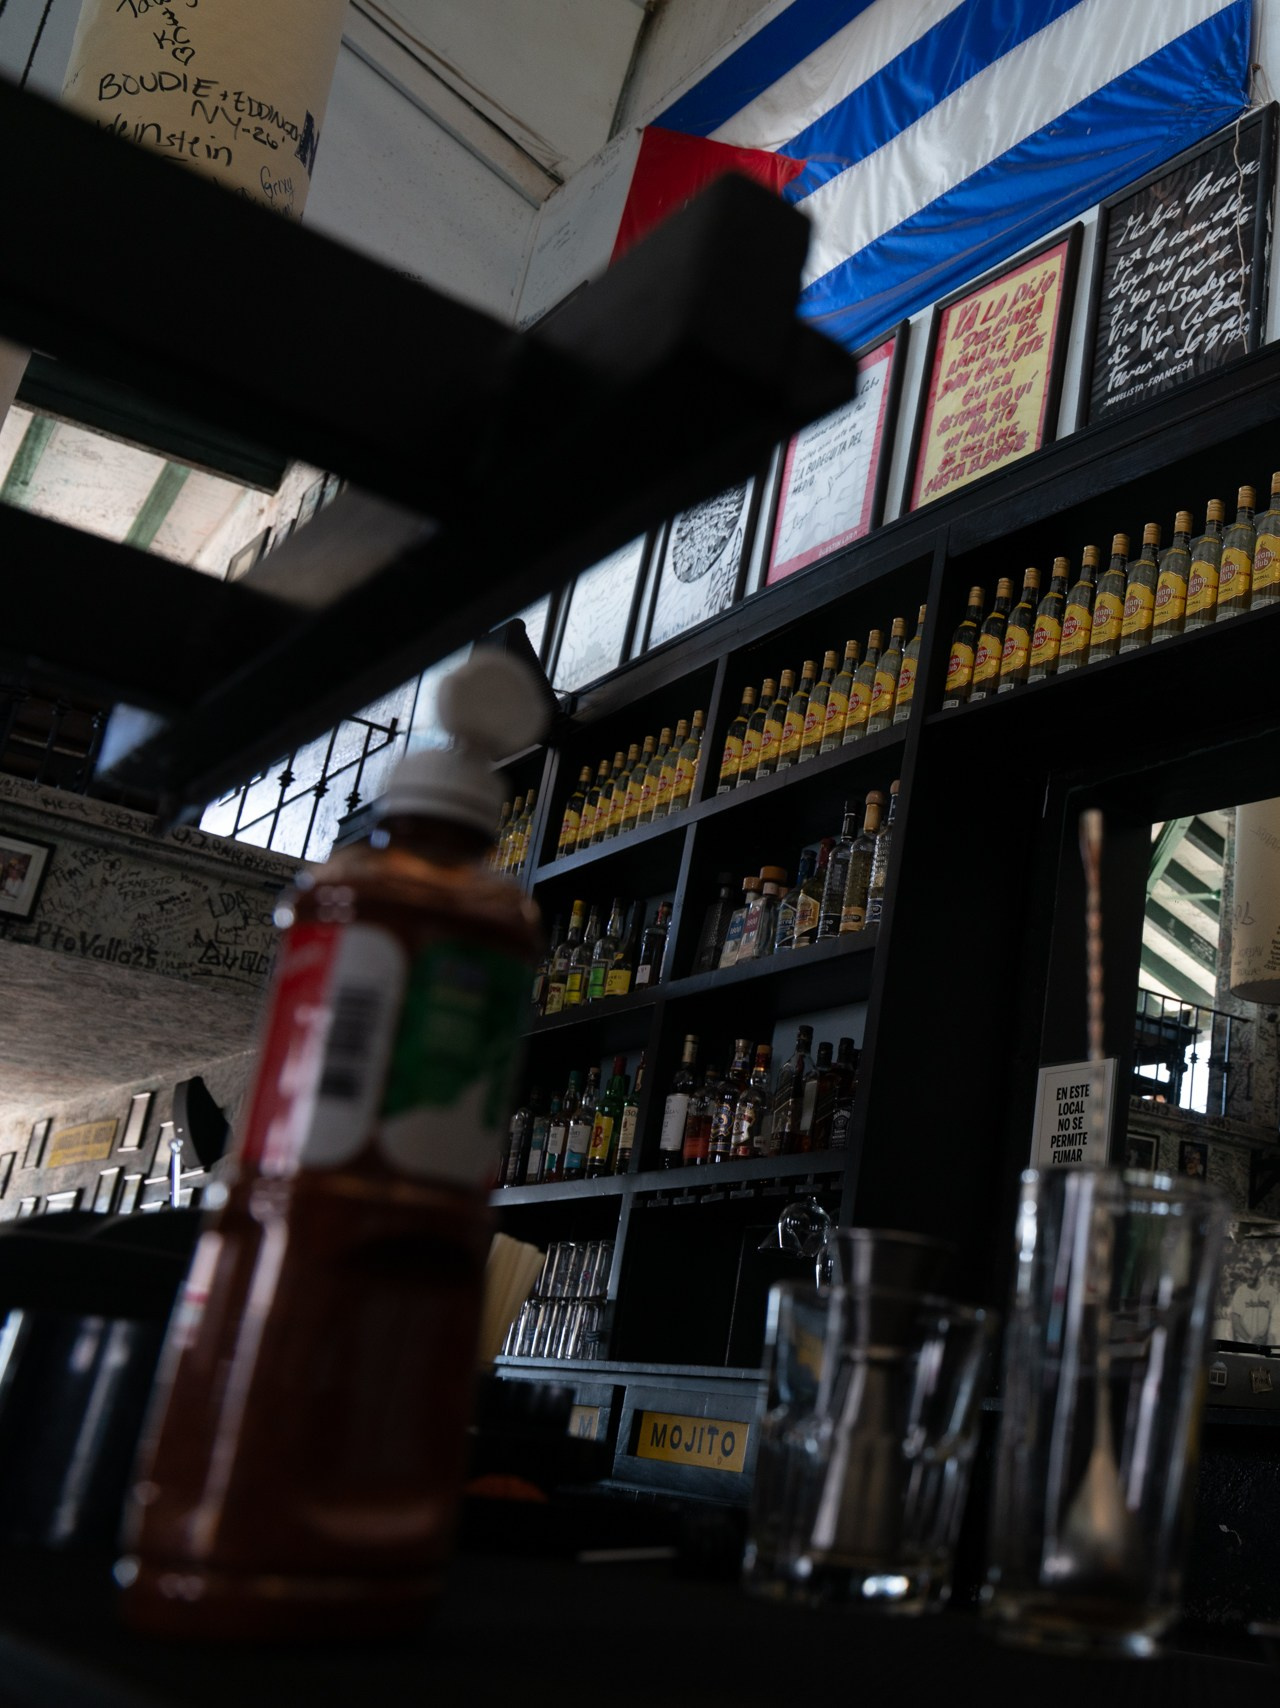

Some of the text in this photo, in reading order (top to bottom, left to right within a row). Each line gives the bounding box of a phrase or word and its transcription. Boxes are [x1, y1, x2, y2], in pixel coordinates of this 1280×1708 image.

[1056, 1084, 1090, 1100] EN ESTE
[1058, 1101, 1085, 1116] LOCAL
[1058, 1117, 1083, 1132] NO SE
[1051, 1132, 1088, 1148] PERMITE
[1052, 1149, 1082, 1163] FUMAR
[650, 1422, 735, 1457] MOJITO
